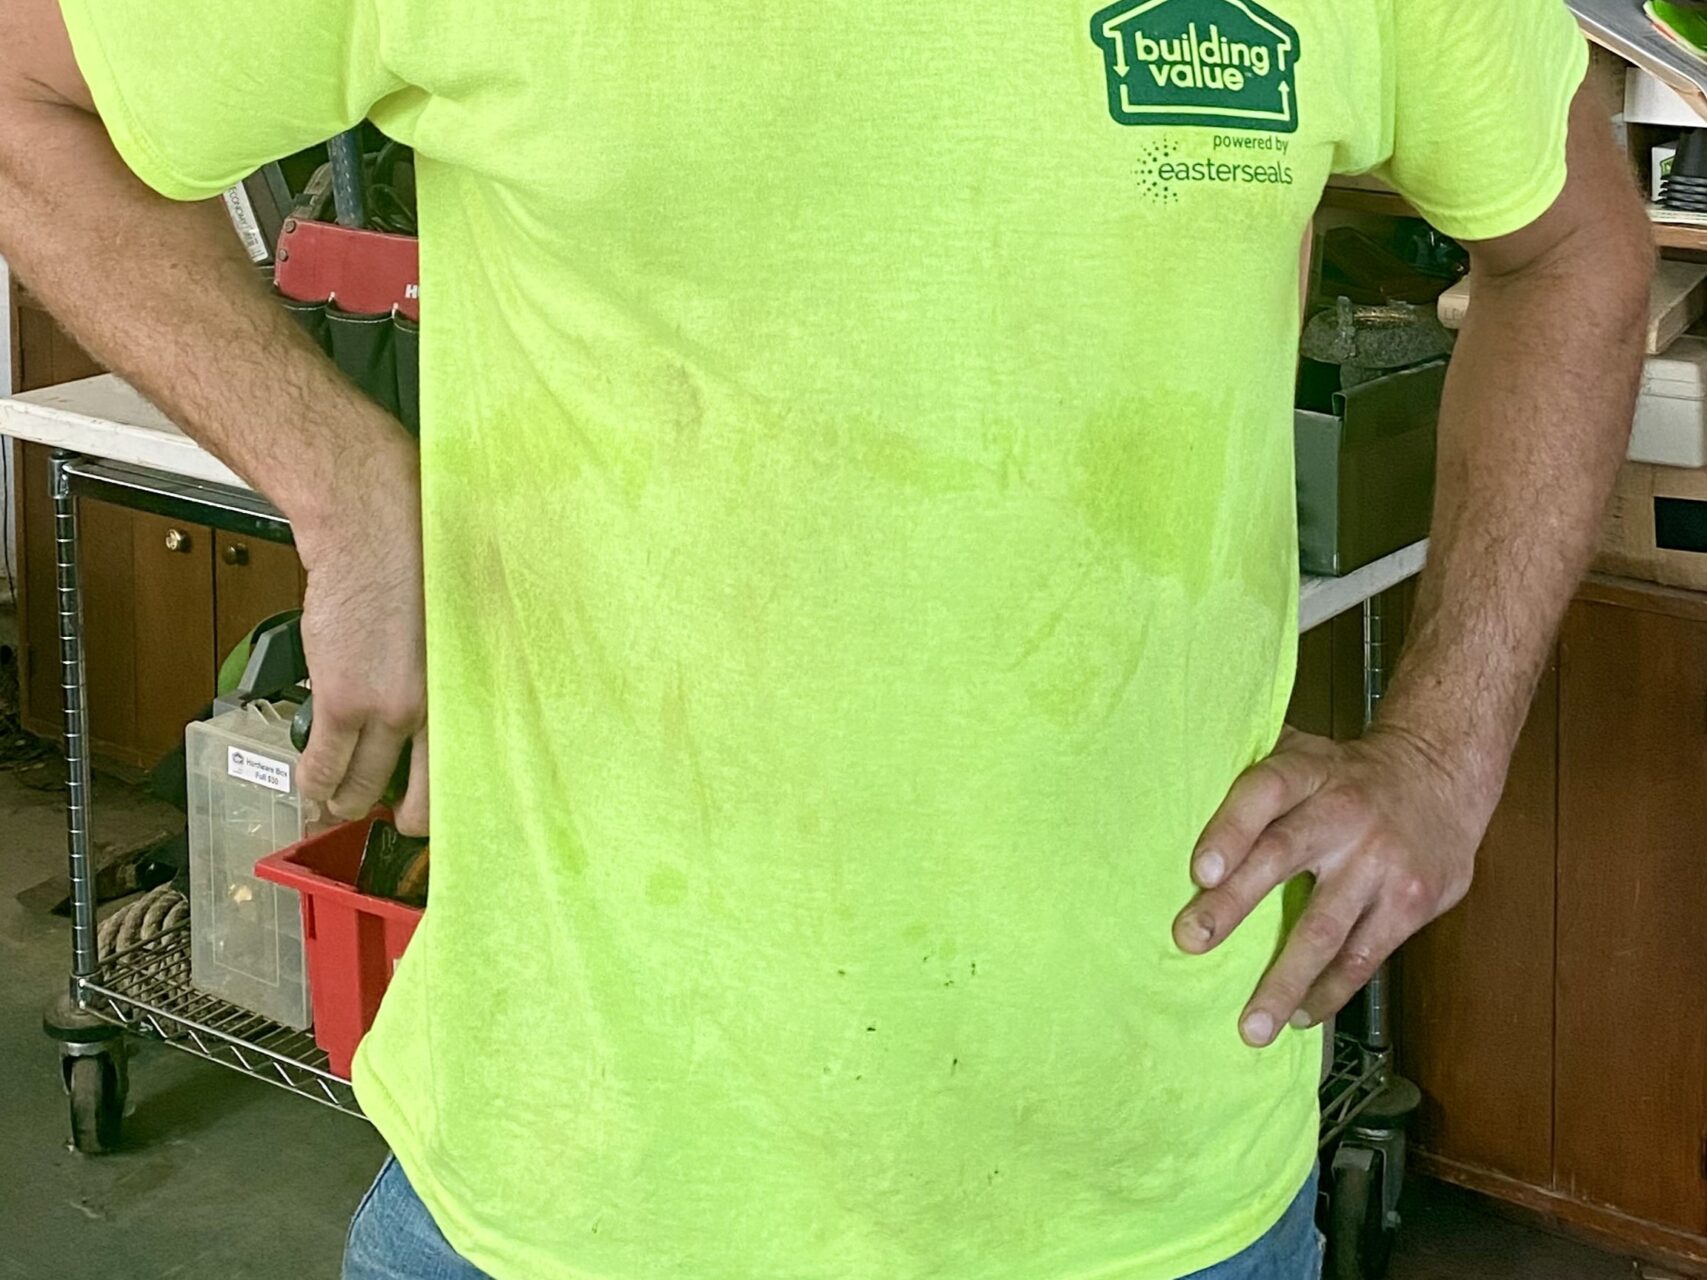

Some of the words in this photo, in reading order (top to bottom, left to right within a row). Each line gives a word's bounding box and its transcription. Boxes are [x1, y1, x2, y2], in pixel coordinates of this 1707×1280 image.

[1135, 22, 1270, 77] building
[1149, 64, 1245, 92] value
[1213, 134, 1273, 151] powered
[1275, 135, 1290, 155] by
[1158, 157, 1294, 186] easterseals
